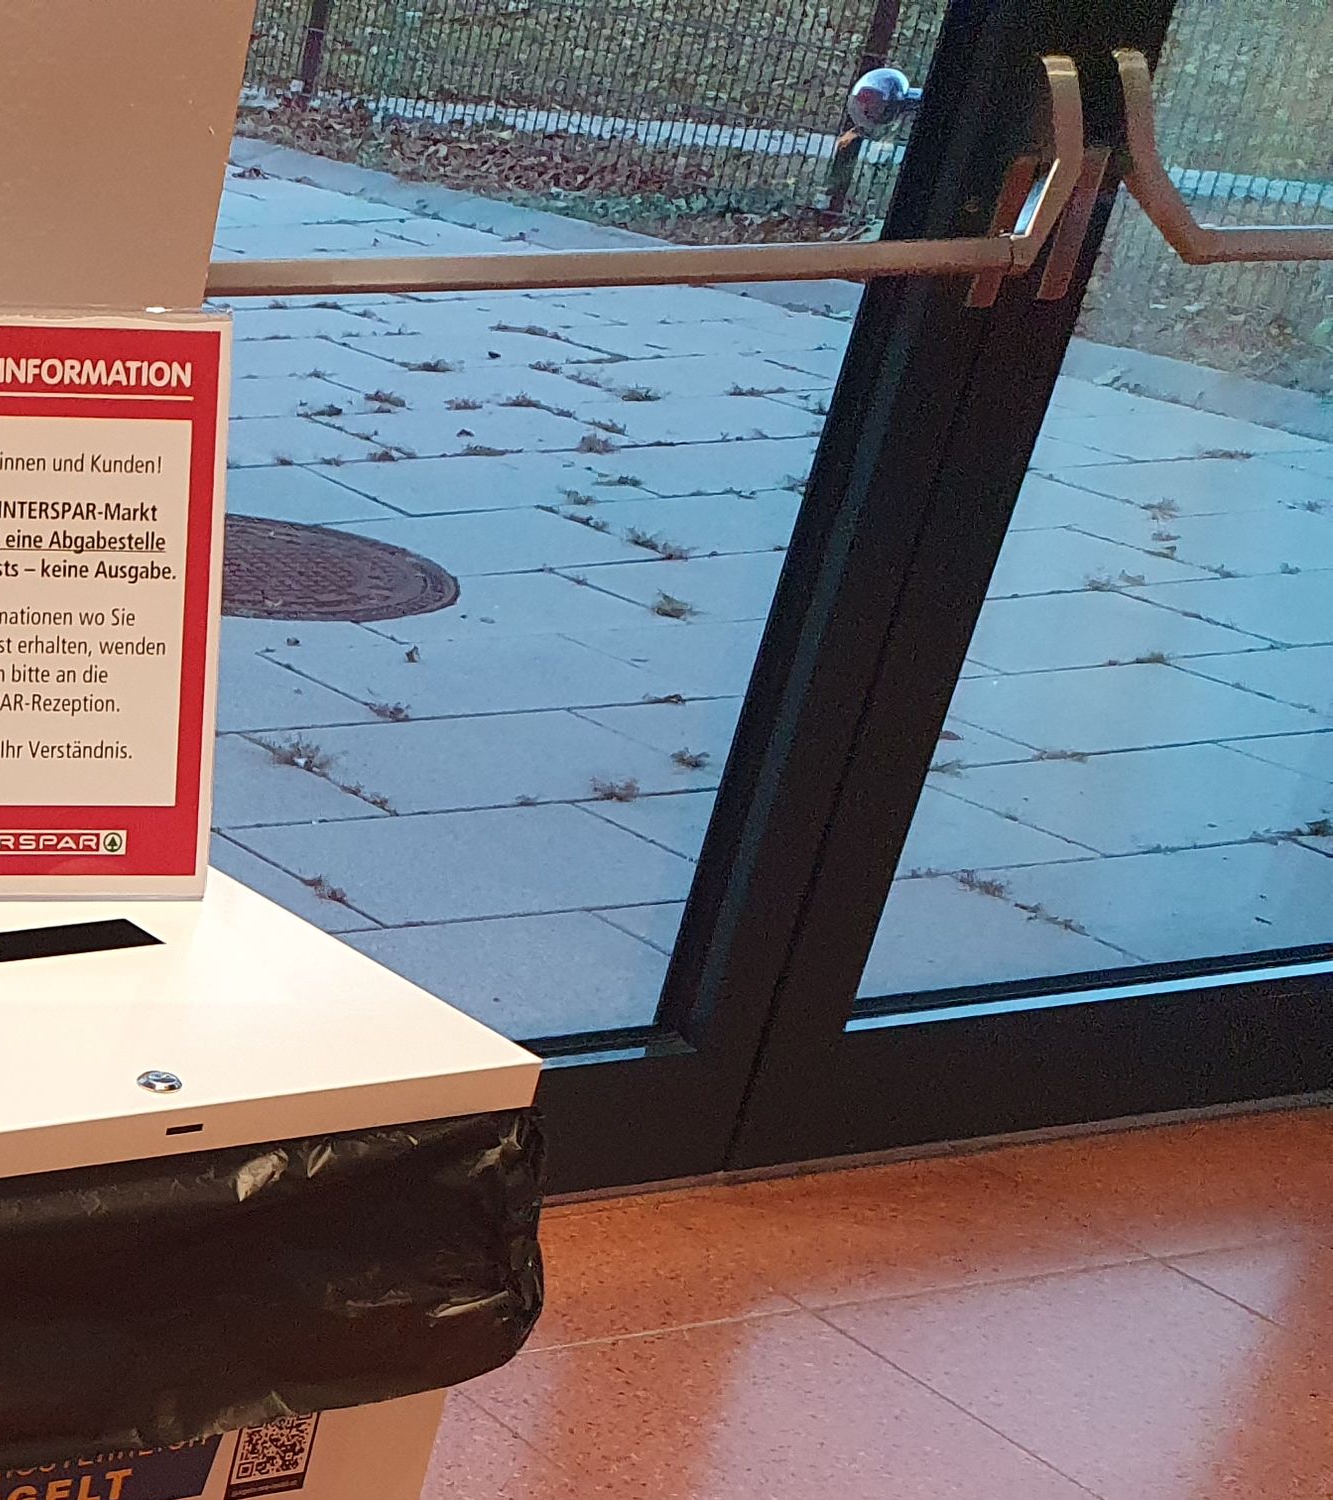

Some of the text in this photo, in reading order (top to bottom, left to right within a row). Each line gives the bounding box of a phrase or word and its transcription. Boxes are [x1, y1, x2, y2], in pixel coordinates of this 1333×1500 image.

[53, 454, 84, 472] und
[91, 455, 161, 473] Kunden!
[5, 531, 43, 549] eine
[48, 531, 166, 555] Abgabestelle
[40, 559, 90, 579] keine
[94, 560, 177, 585] Ausgabe.
[79, 613, 104, 625] wo
[112, 608, 135, 626] Sie
[18, 635, 91, 656] erhalten,
[100, 637, 165, 655] wenden
[12, 664, 49, 682] bitte
[57, 670, 75, 682] an
[83, 665, 107, 683] die
[1, 740, 22, 758] Ihr
[29, 740, 131, 758] Verständnis.
